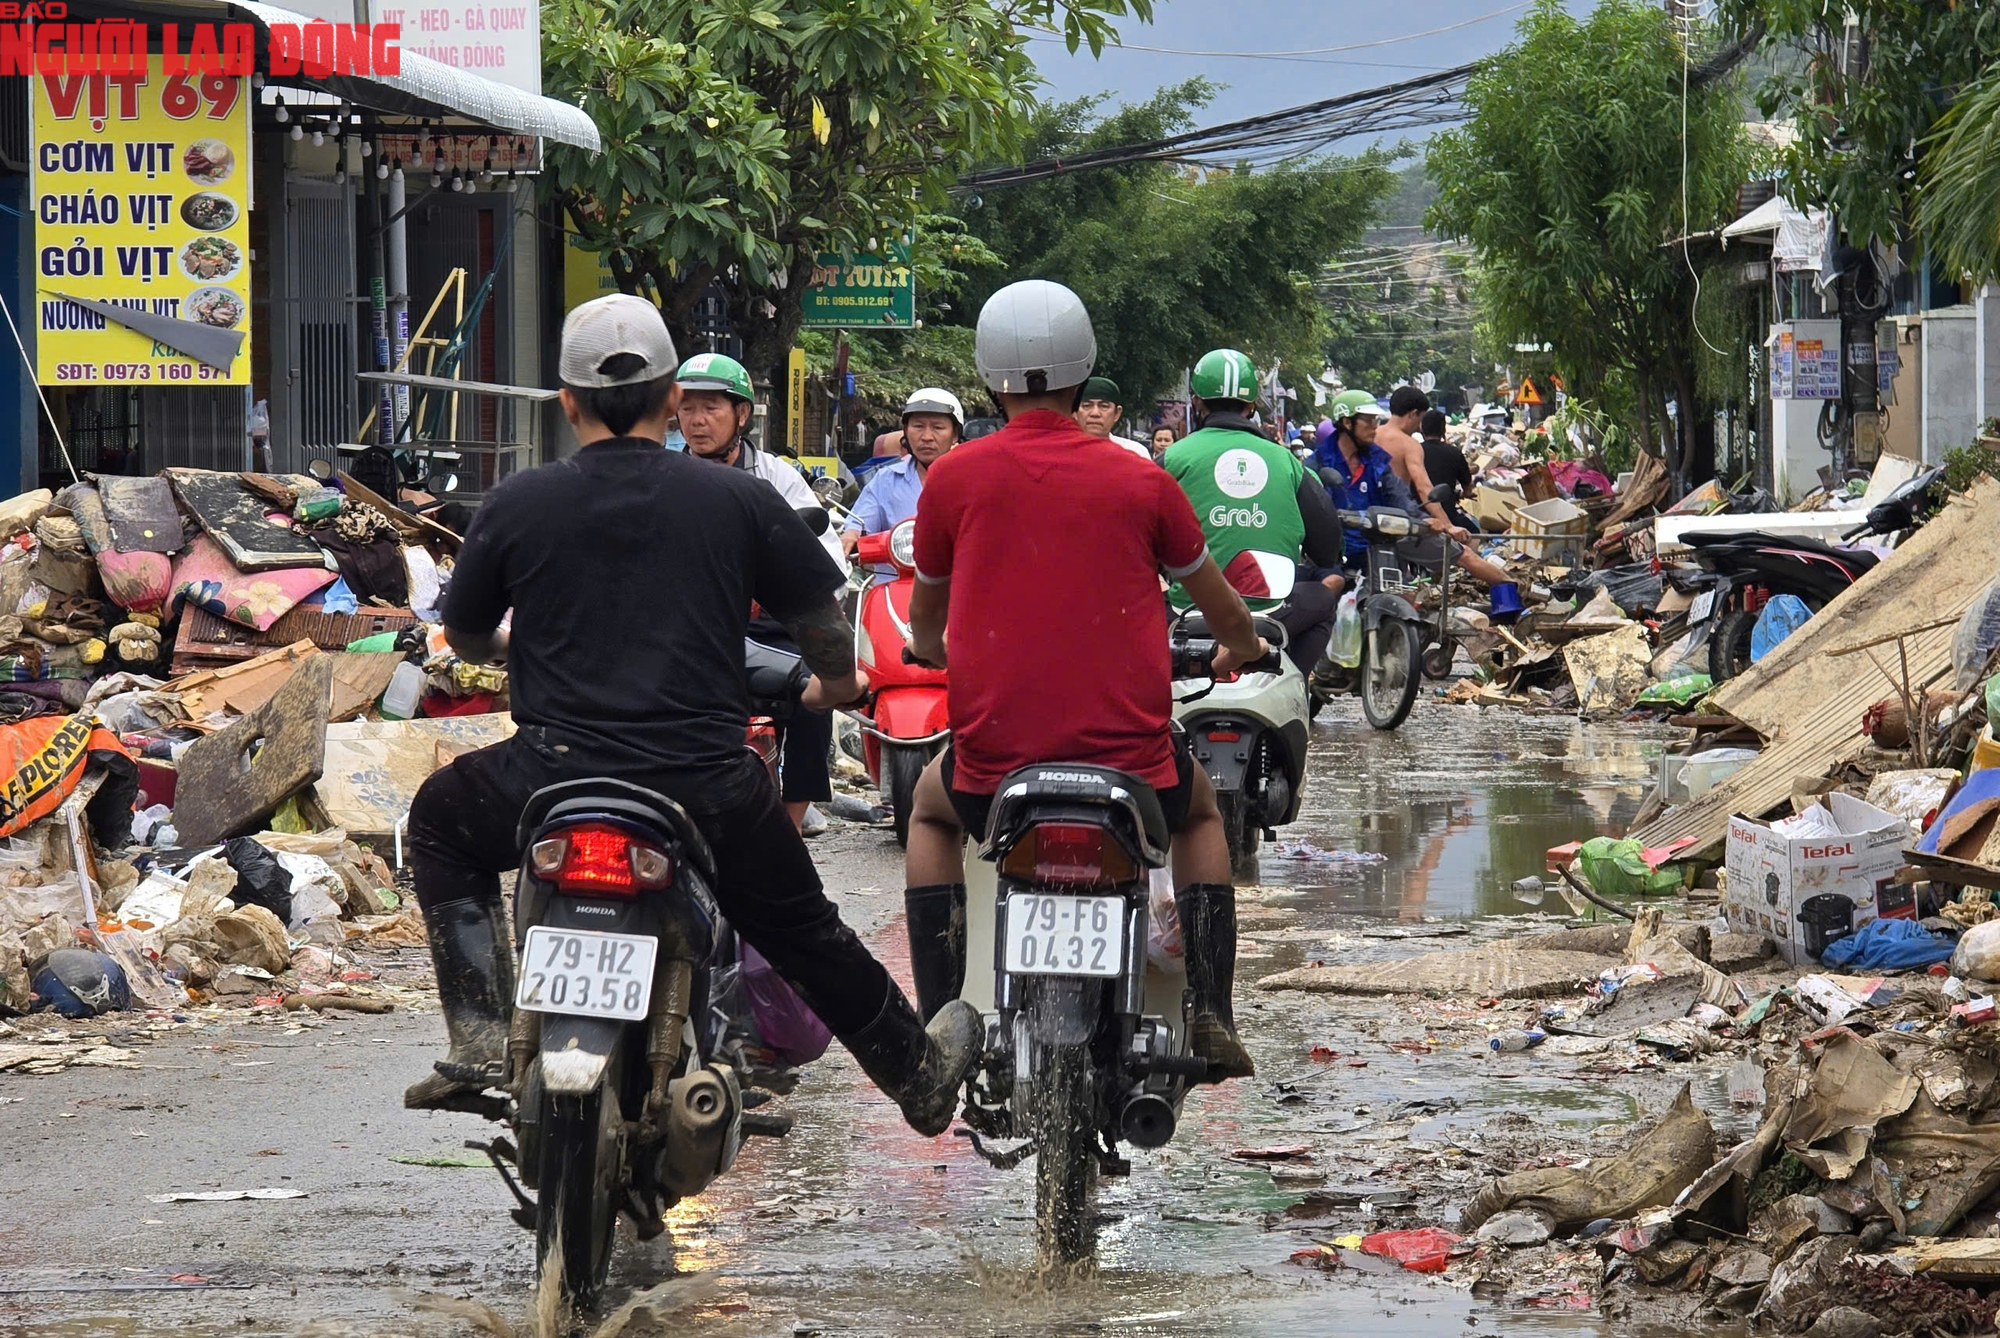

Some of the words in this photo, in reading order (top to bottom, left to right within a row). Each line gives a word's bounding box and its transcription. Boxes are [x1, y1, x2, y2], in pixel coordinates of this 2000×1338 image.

[421, 9, 449, 31] HEO
[465, 3, 485, 30] GÀ
[490, 8, 526, 32] QUAY
[463, 42, 505, 67] ĐÔNG
[41, 68, 148, 132] VỊT
[161, 66, 240, 120] 69
[39, 140, 114, 172] CƠM
[125, 143, 174, 179] VỊT
[40, 188, 119, 224] CHÁO
[128, 195, 173, 231] VỊT
[41, 237, 103, 276] GỎI
[116, 246, 174, 283] VỊT
[57, 364, 97, 380] SĐT:
[103, 364, 150, 380] 0973
[157, 364, 192, 380] 160
[1226, 479, 1256, 487] GrabBike
[1209, 503, 1267, 529] Grab
[1038, 771, 1106, 784] HONDA
[1731, 824, 1757, 845] Tefal
[1800, 842, 1855, 859] Tefal
[575, 905, 616, 916] HONDA
[1023, 898, 1108, 933] 79-F6
[545, 935, 635, 975] 79-H2
[1020, 935, 1107, 970] 0432
[521, 972, 642, 1012] 203.58
